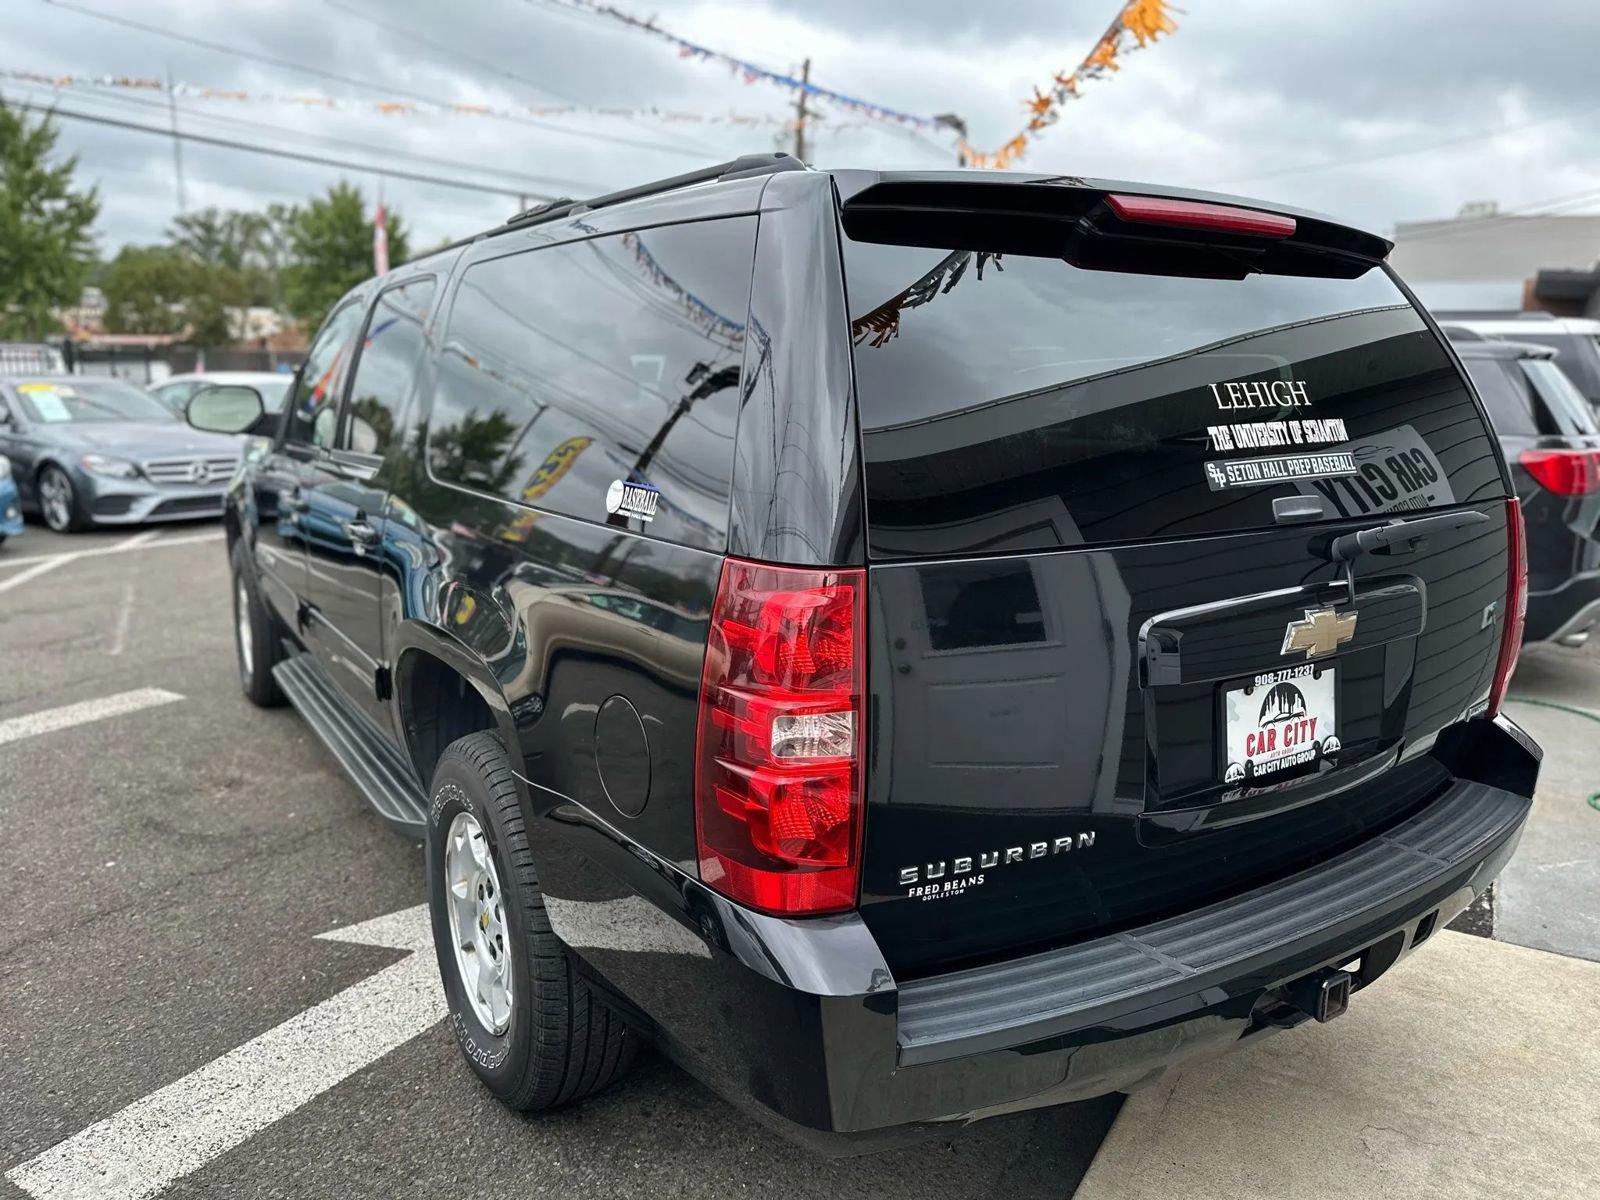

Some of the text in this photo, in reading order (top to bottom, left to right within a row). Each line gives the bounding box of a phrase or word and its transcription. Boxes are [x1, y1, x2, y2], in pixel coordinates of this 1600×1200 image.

[1208, 380, 1312, 410] LEHIGH
[1206, 425, 1235, 451] THE
[1229, 420, 1291, 449] UNIVERSITY
[1288, 420, 1304, 444] OF
[1226, 455, 1357, 482] SETON HALL PREP BASEBALL
[620, 486, 659, 516] BASEBALL
[1254, 663, 1315, 687] 908-777-1237
[1246, 717, 1318, 758] CAR CITY
[1253, 749, 1316, 777] CAR CITY AUTO GROUP
[899, 831, 1096, 886] SUBURBAN
[908, 874, 985, 898] FRED BEANS
